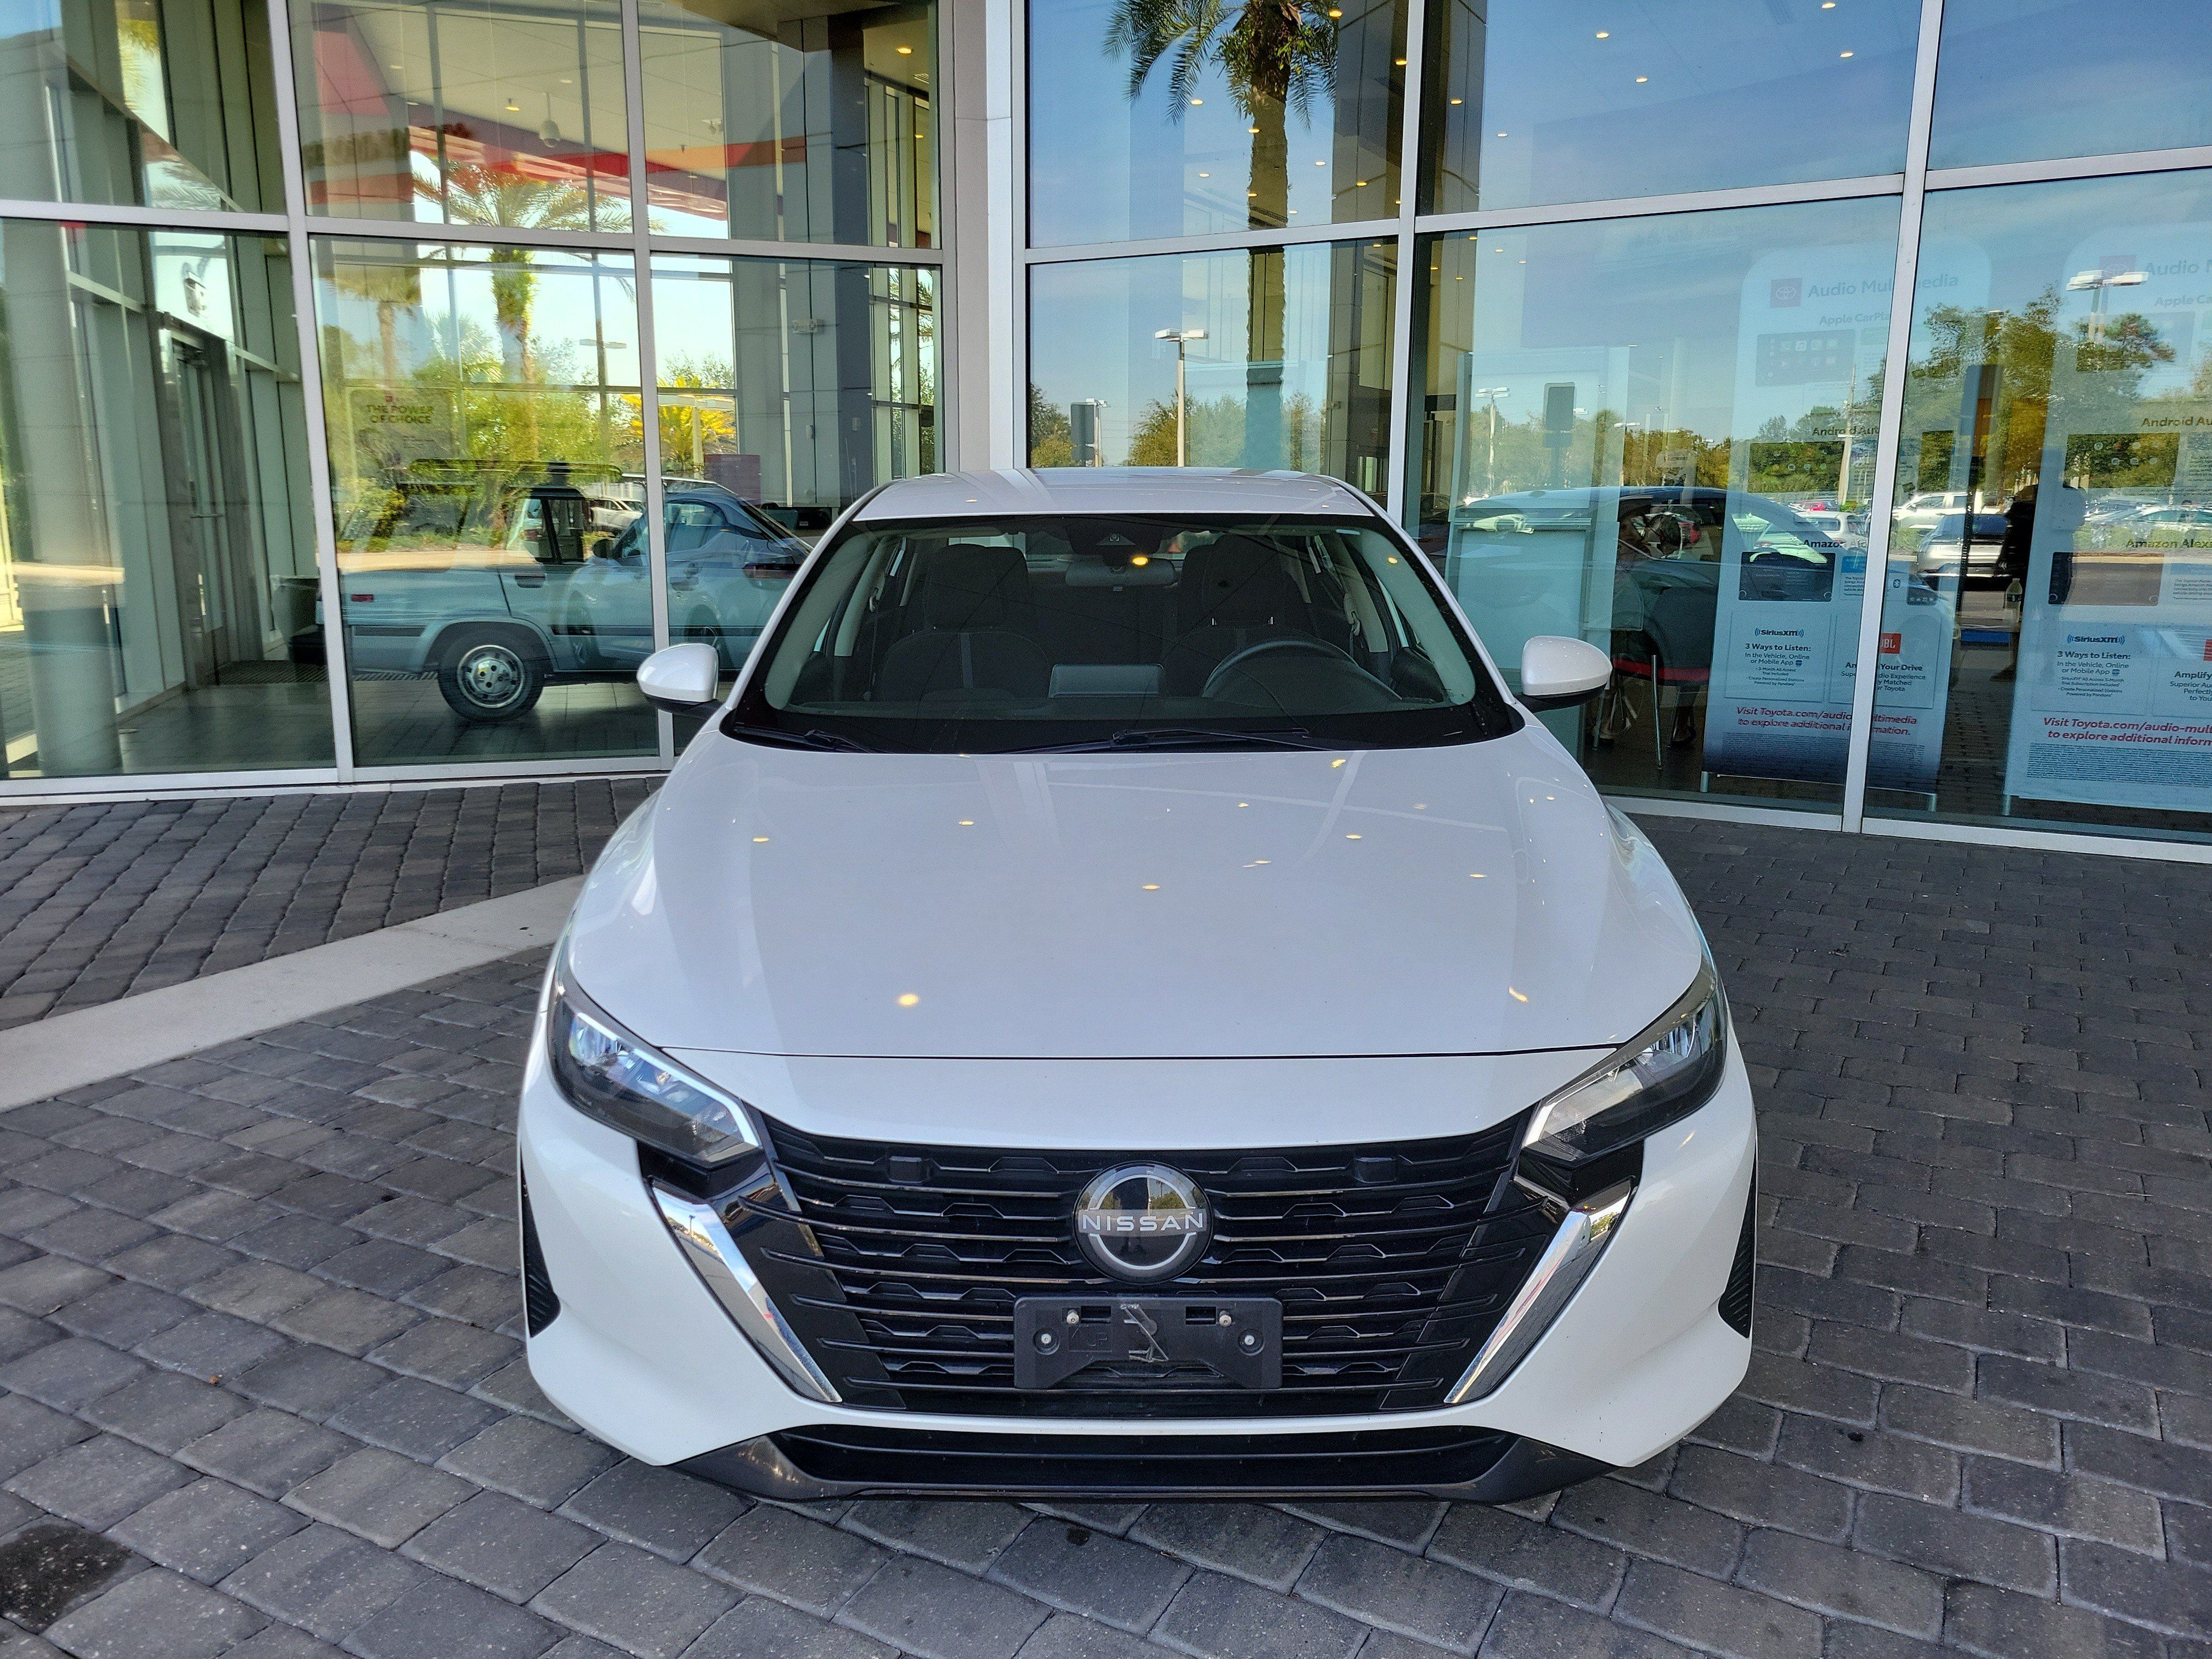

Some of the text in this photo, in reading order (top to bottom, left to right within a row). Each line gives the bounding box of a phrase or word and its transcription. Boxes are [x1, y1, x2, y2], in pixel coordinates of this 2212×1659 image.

[1808, 274, 1958, 298] Audio Muledia
[2154, 295, 2193, 308] Apple
[1820, 312, 1890, 326] Apple CarPla
[2141, 416, 2193, 426] Android
[1812, 426, 1857, 436] Androd
[1803, 539, 1846, 548] Amazo
[2126, 539, 2177, 548] Amazon
[2175, 672, 2212, 680] Amplify
[1736, 707, 1758, 715] Visit
[1751, 719, 1789, 728] explore
[1791, 720, 1845, 731] additional
[2044, 717, 2070, 726] Visit
[2062, 731, 2108, 741] explore
[2110, 733, 2173, 744] additional
[1082, 1213, 1203, 1231] NISSAN
